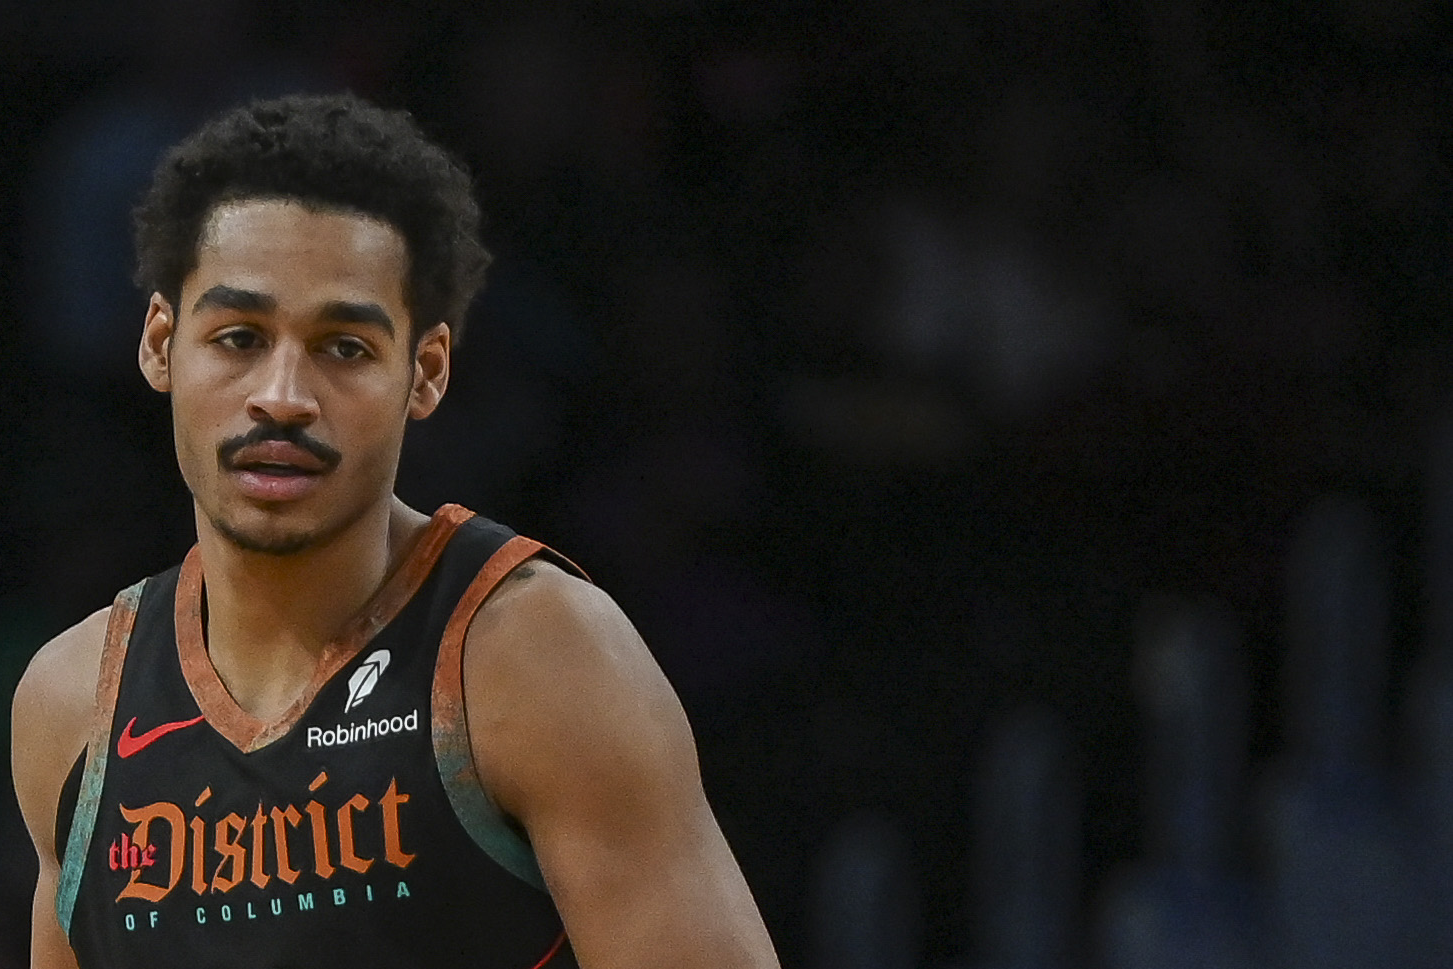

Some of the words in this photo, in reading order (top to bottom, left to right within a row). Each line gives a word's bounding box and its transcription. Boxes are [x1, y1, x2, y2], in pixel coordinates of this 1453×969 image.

[307, 709, 418, 748] Robinhood
[109, 832, 157, 871] the
[115, 770, 416, 904] District
[125, 910, 159, 932] OF
[196, 880, 412, 925] COLUMBIA
